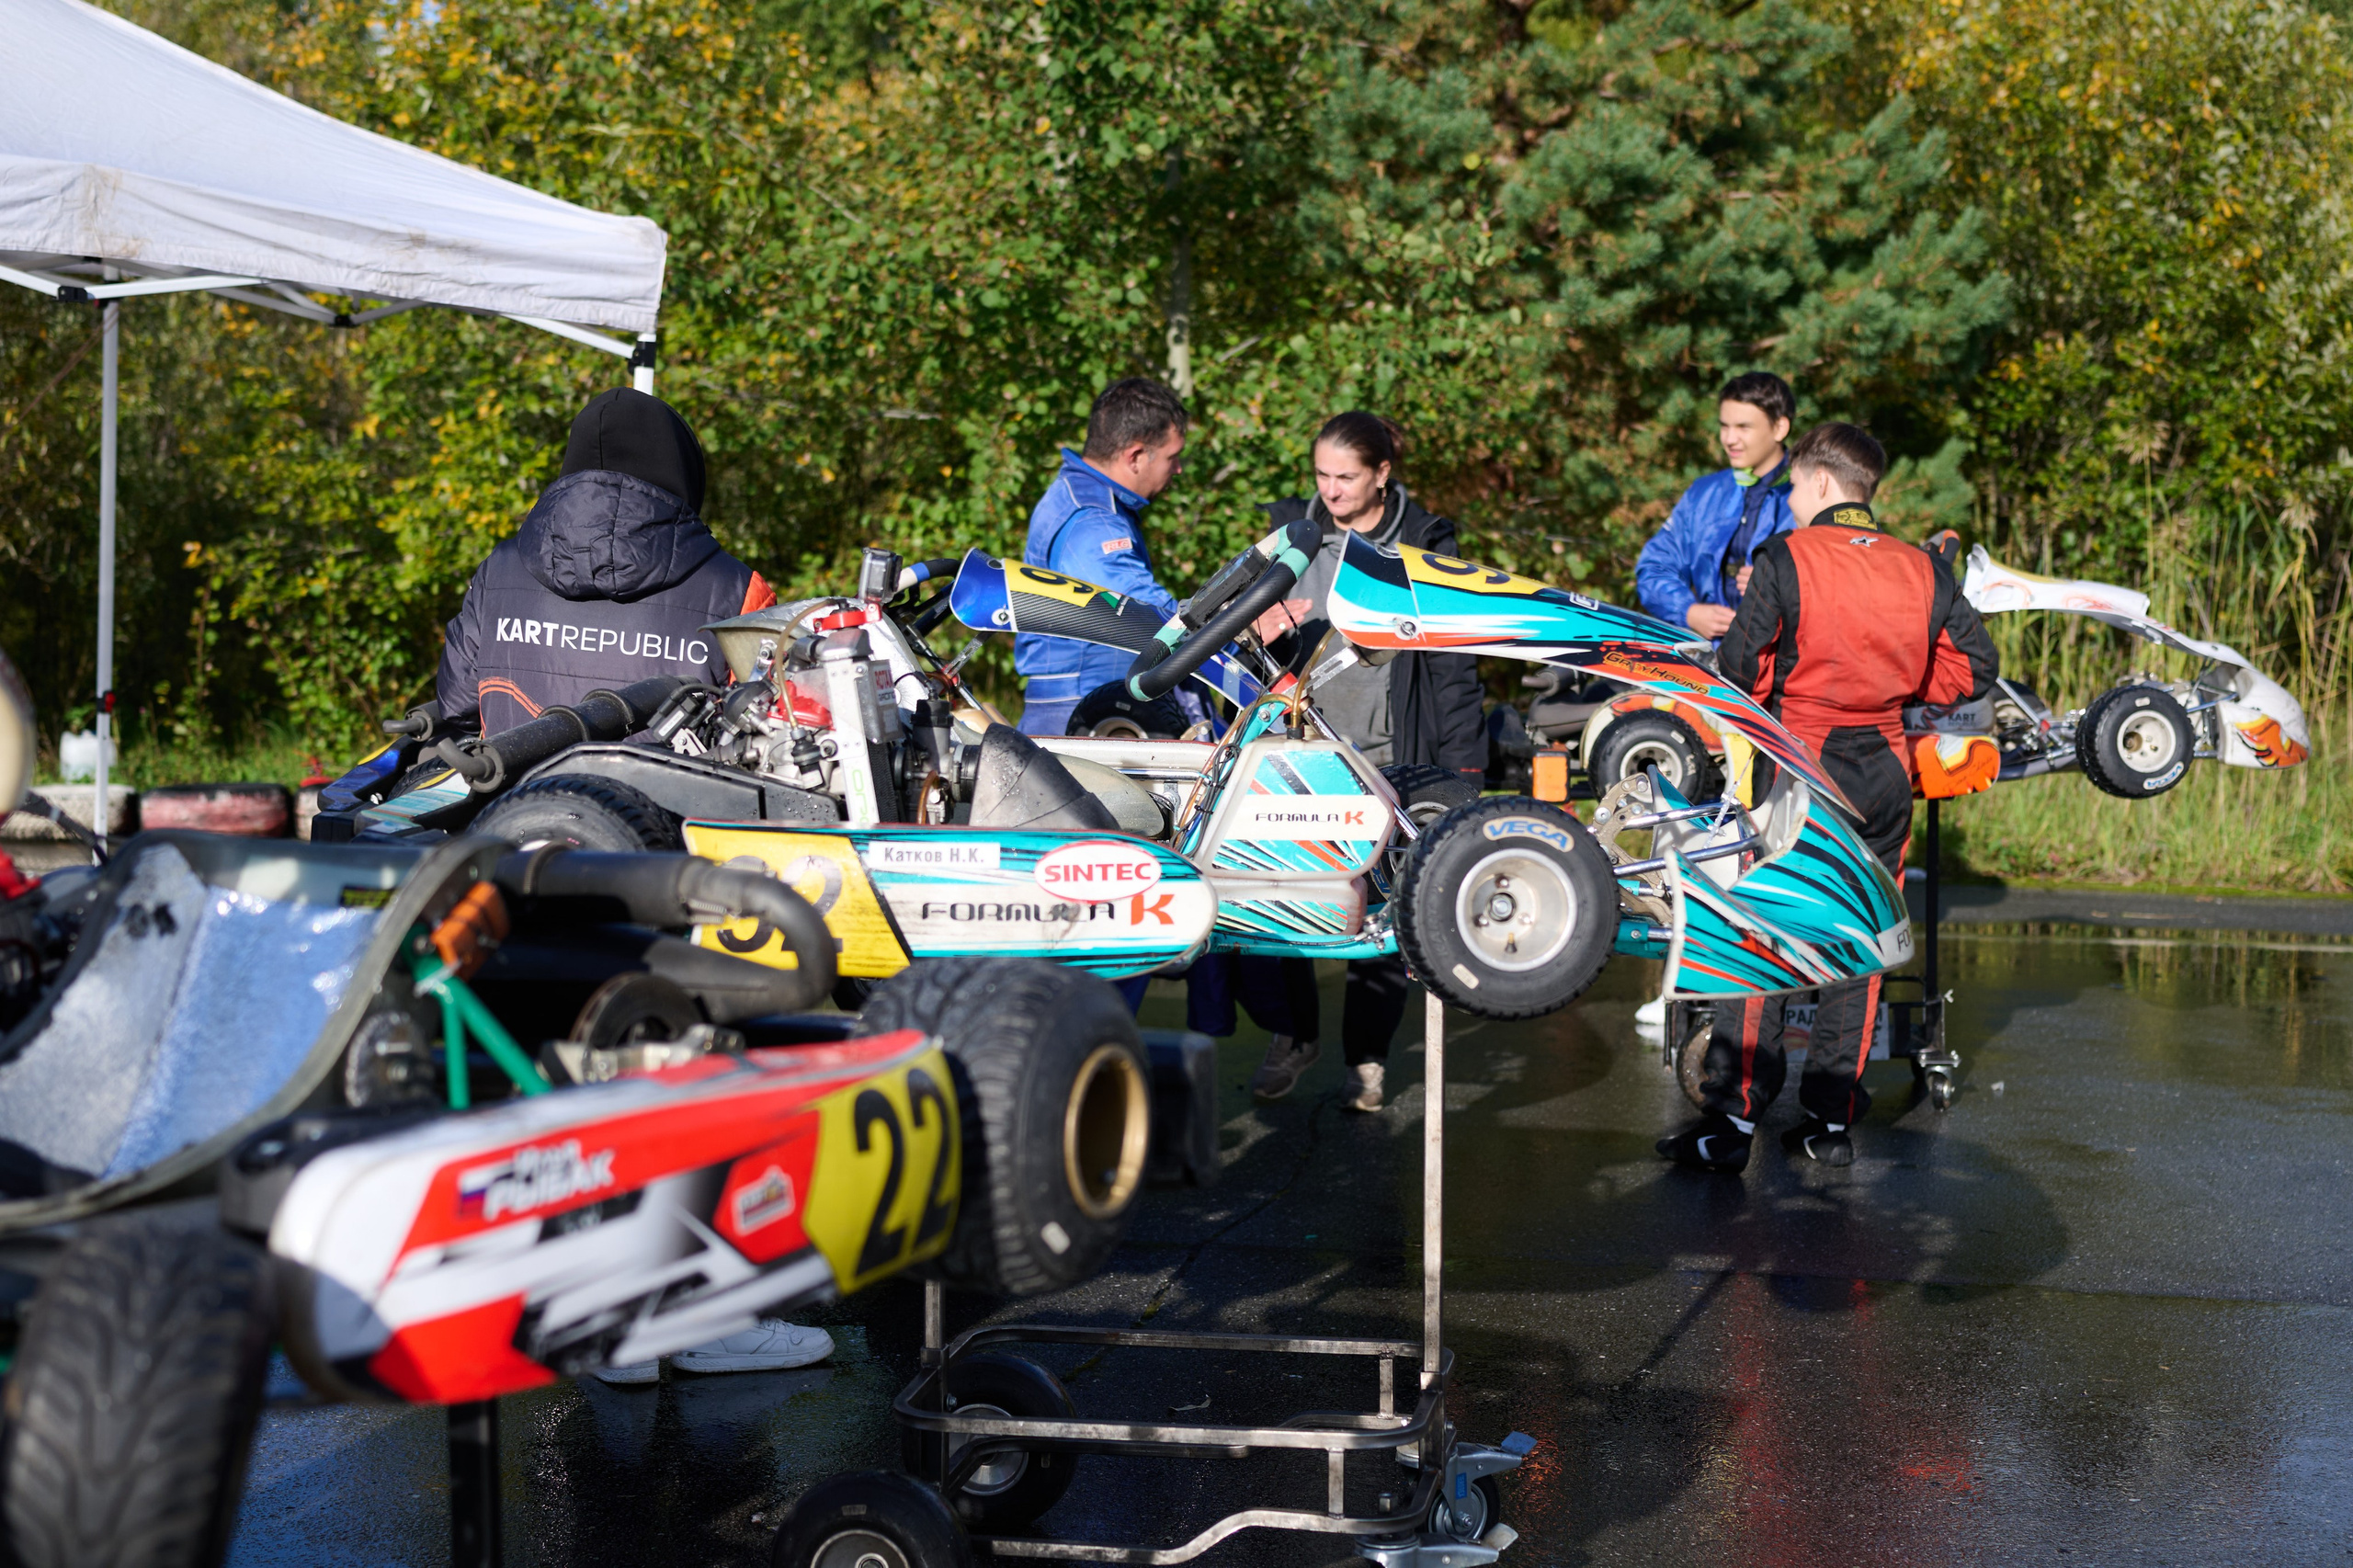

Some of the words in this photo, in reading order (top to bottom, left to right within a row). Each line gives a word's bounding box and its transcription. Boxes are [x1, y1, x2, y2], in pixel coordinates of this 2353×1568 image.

[496, 618, 709, 665] KARTREPUBLIC
[1256, 812, 1339, 823] FORMULA
[1345, 811, 1365, 825] K
[1487, 820, 1569, 850] VEGA
[884, 846, 942, 863] Катков
[949, 847, 984, 863] Н.К.
[1044, 862, 1152, 883] SINTEC
[922, 902, 1115, 923] FORMULA
[1131, 893, 1175, 926] K
[854, 1067, 952, 1279] 22
